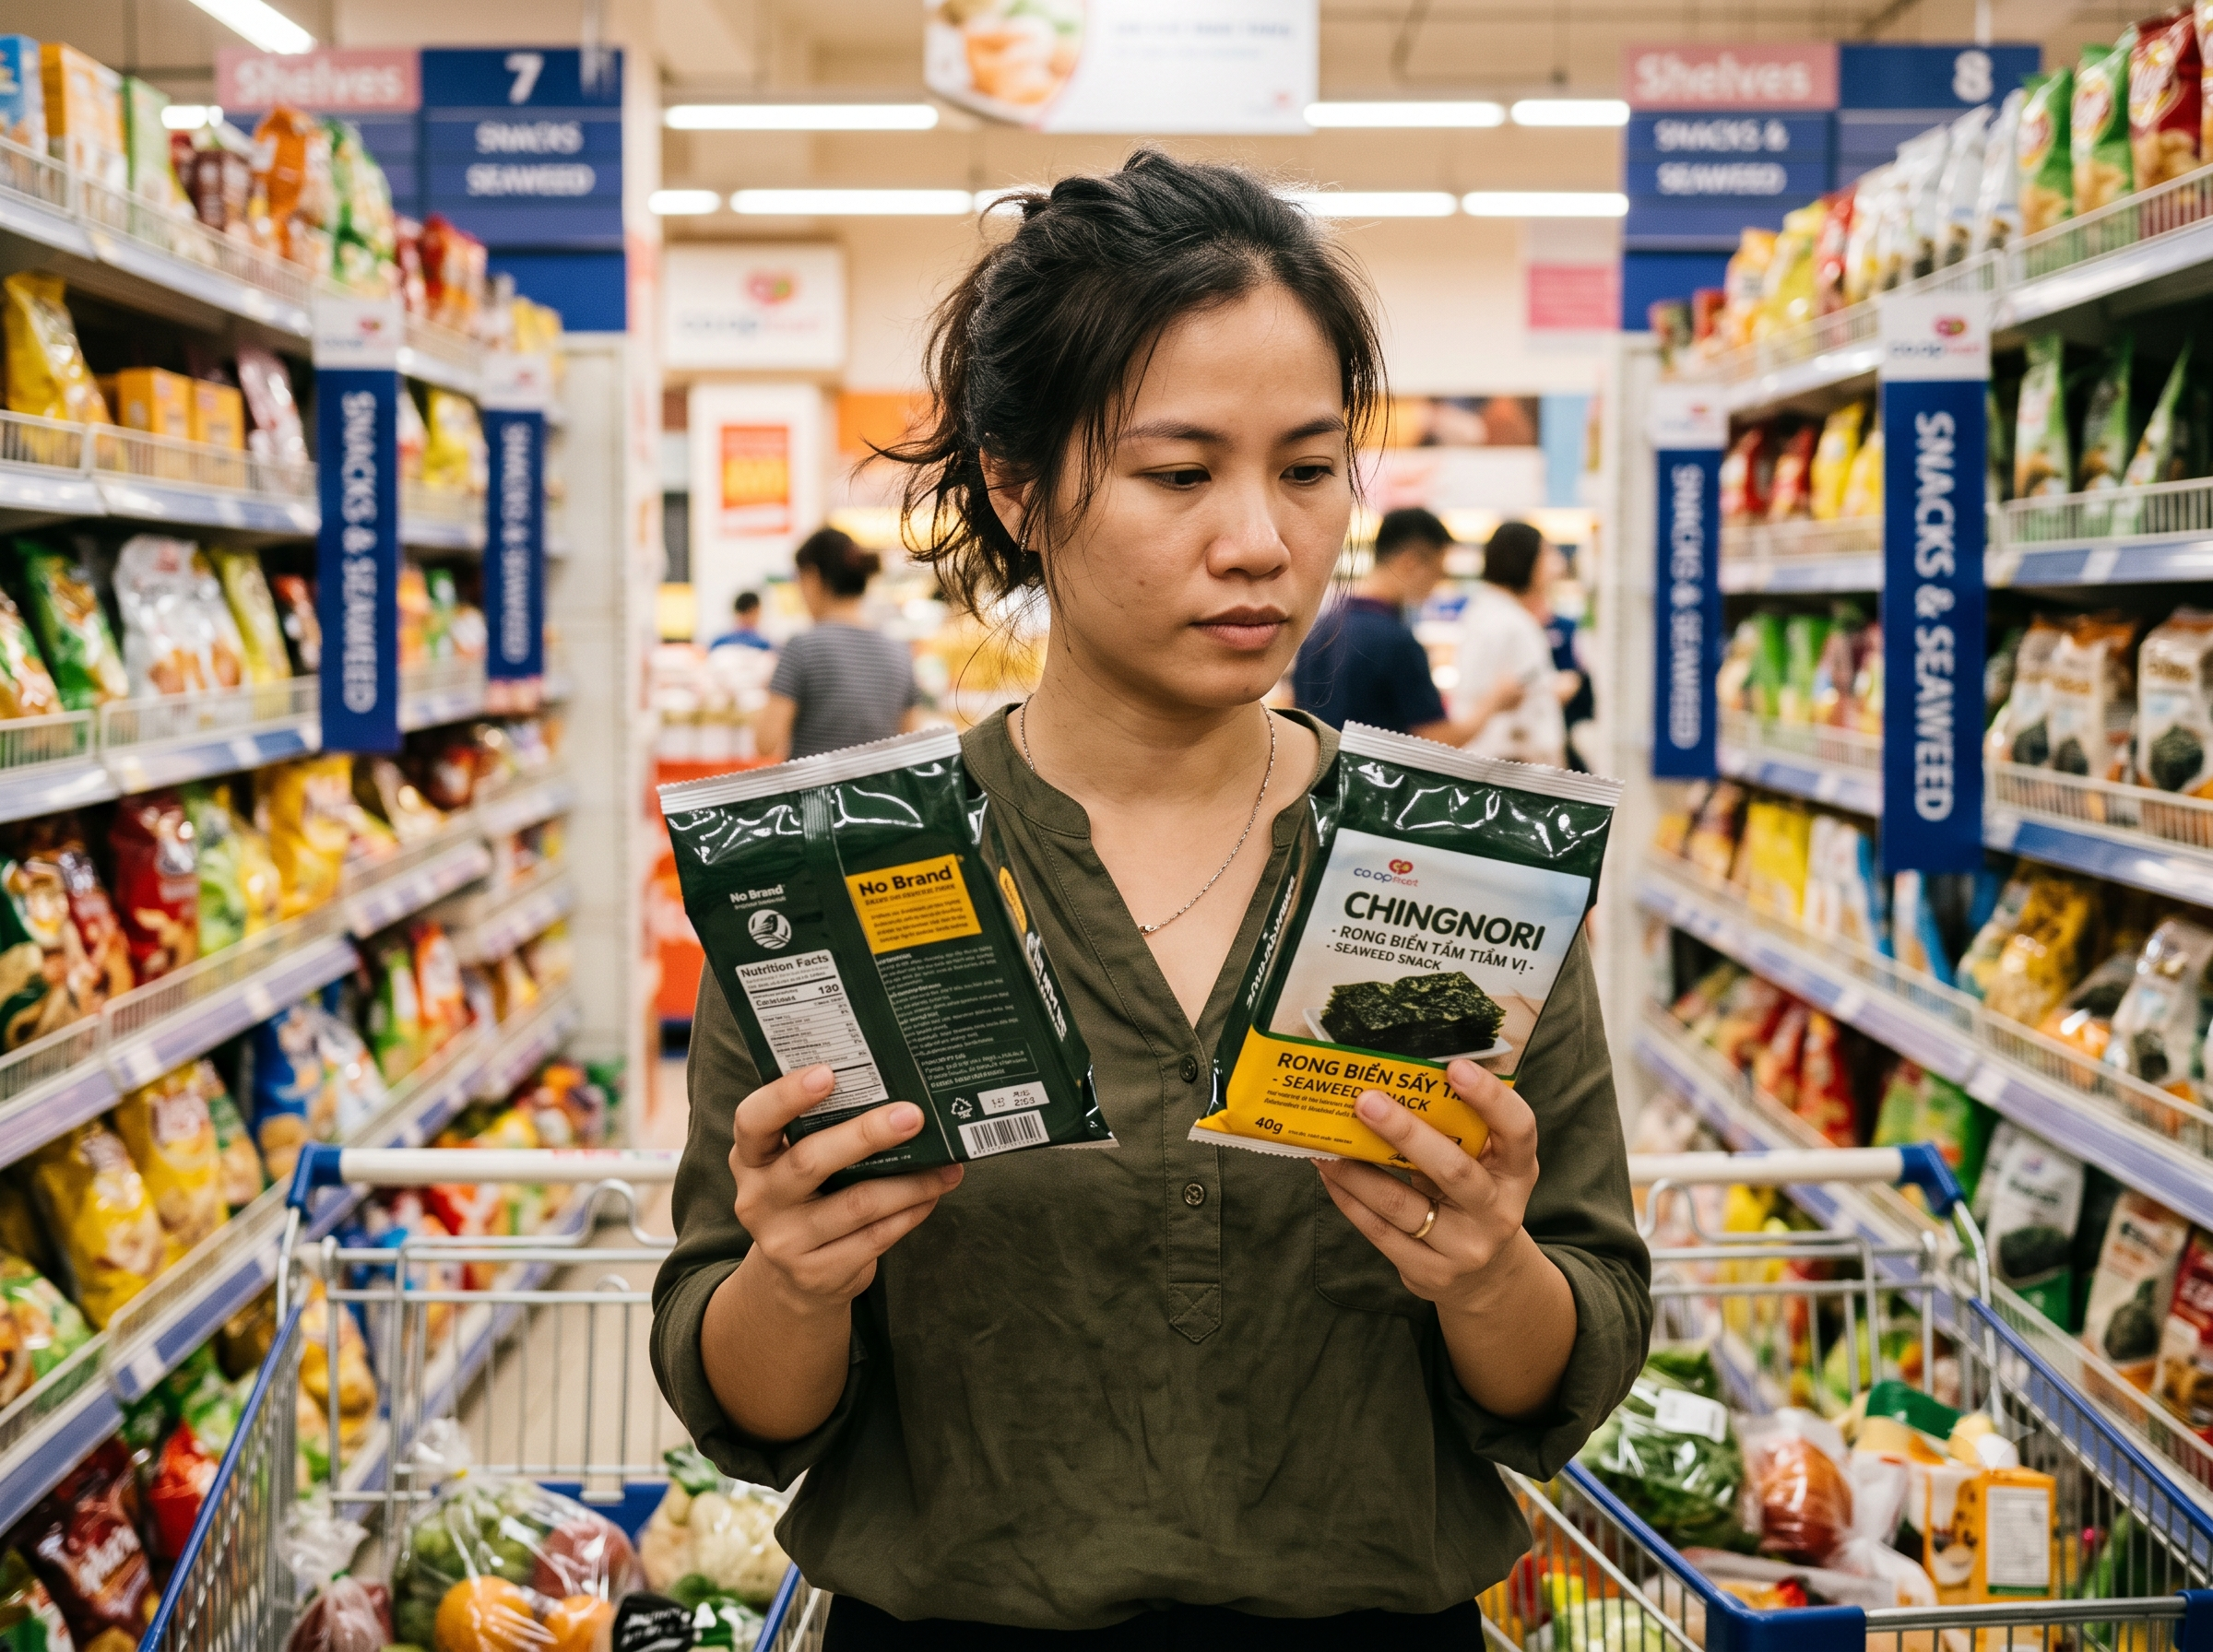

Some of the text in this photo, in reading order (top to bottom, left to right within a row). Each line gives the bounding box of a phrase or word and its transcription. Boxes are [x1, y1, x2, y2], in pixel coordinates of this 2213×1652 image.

[234, 54, 403, 104] Shelves
[503, 53, 544, 104] 7
[1635, 52, 1810, 100] Shelves
[1952, 50, 1994, 103] 8
[475, 121, 584, 154] SNACKS
[1654, 119, 1761, 152] SNACKS
[466, 163, 596, 196] SEAWEED
[1657, 162, 1787, 195] SEAWEED
[341, 391, 377, 524] SNACKS
[1671, 463, 1704, 582] SNACKS
[343, 557, 377, 714] SEAWEED
[1914, 410, 1956, 822] SNACKS & SEAWEED
[1669, 611, 1703, 749] SEAWEED
[729, 892, 748, 903] No
[748, 883, 784, 900] Brand
[858, 880, 888, 897] No
[892, 864, 953, 891] Brand
[1343, 891, 1546, 951] CHINGNORI
[740, 962, 794, 978] Nutrition
[796, 954, 829, 968] Facts
[1333, 941, 1443, 971] SEAWEED SNACK
[1339, 925, 1387, 945] RONG
[1511, 957, 1528, 975] VỊ
[1277, 1052, 1341, 1077] RONG
[1282, 1074, 1365, 1099] SEAWEED
[1255, 1116, 1284, 1135] 40g
